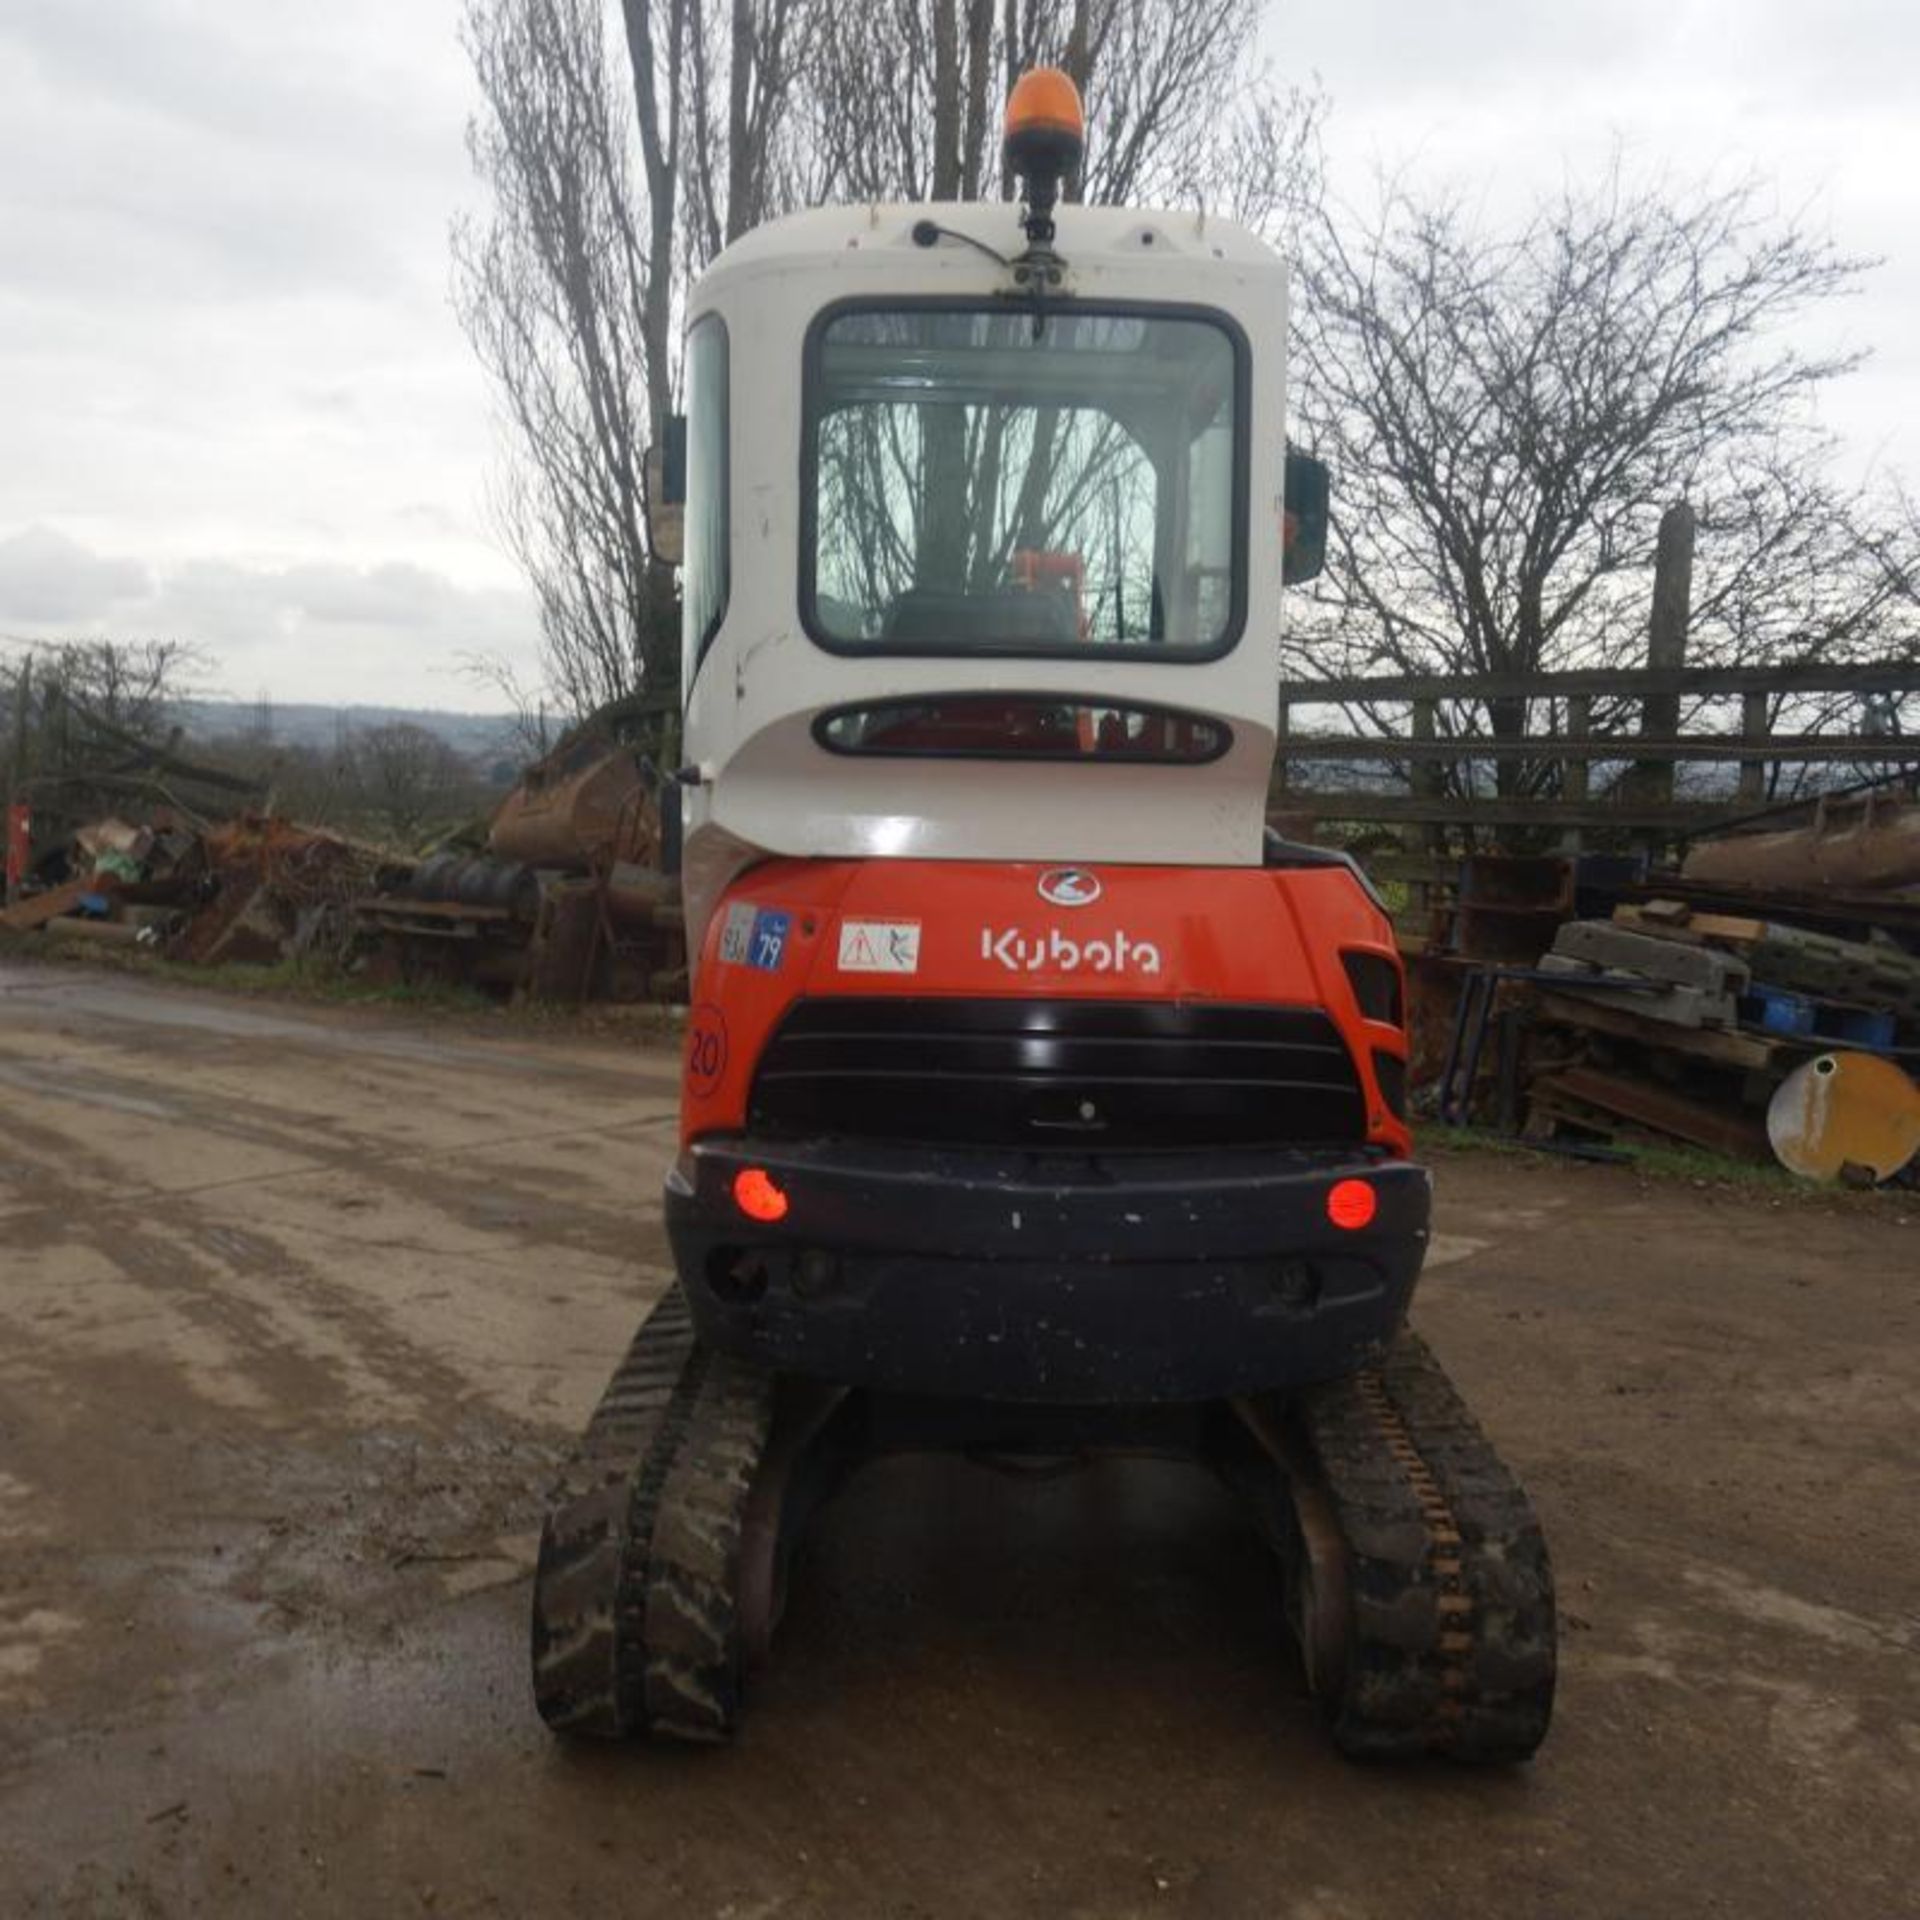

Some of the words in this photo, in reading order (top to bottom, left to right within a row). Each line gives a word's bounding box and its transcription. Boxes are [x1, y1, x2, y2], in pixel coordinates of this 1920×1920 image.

[758, 934, 781, 969] 79
[981, 927, 1160, 973] Kubota
[690, 1032, 719, 1076] 20
